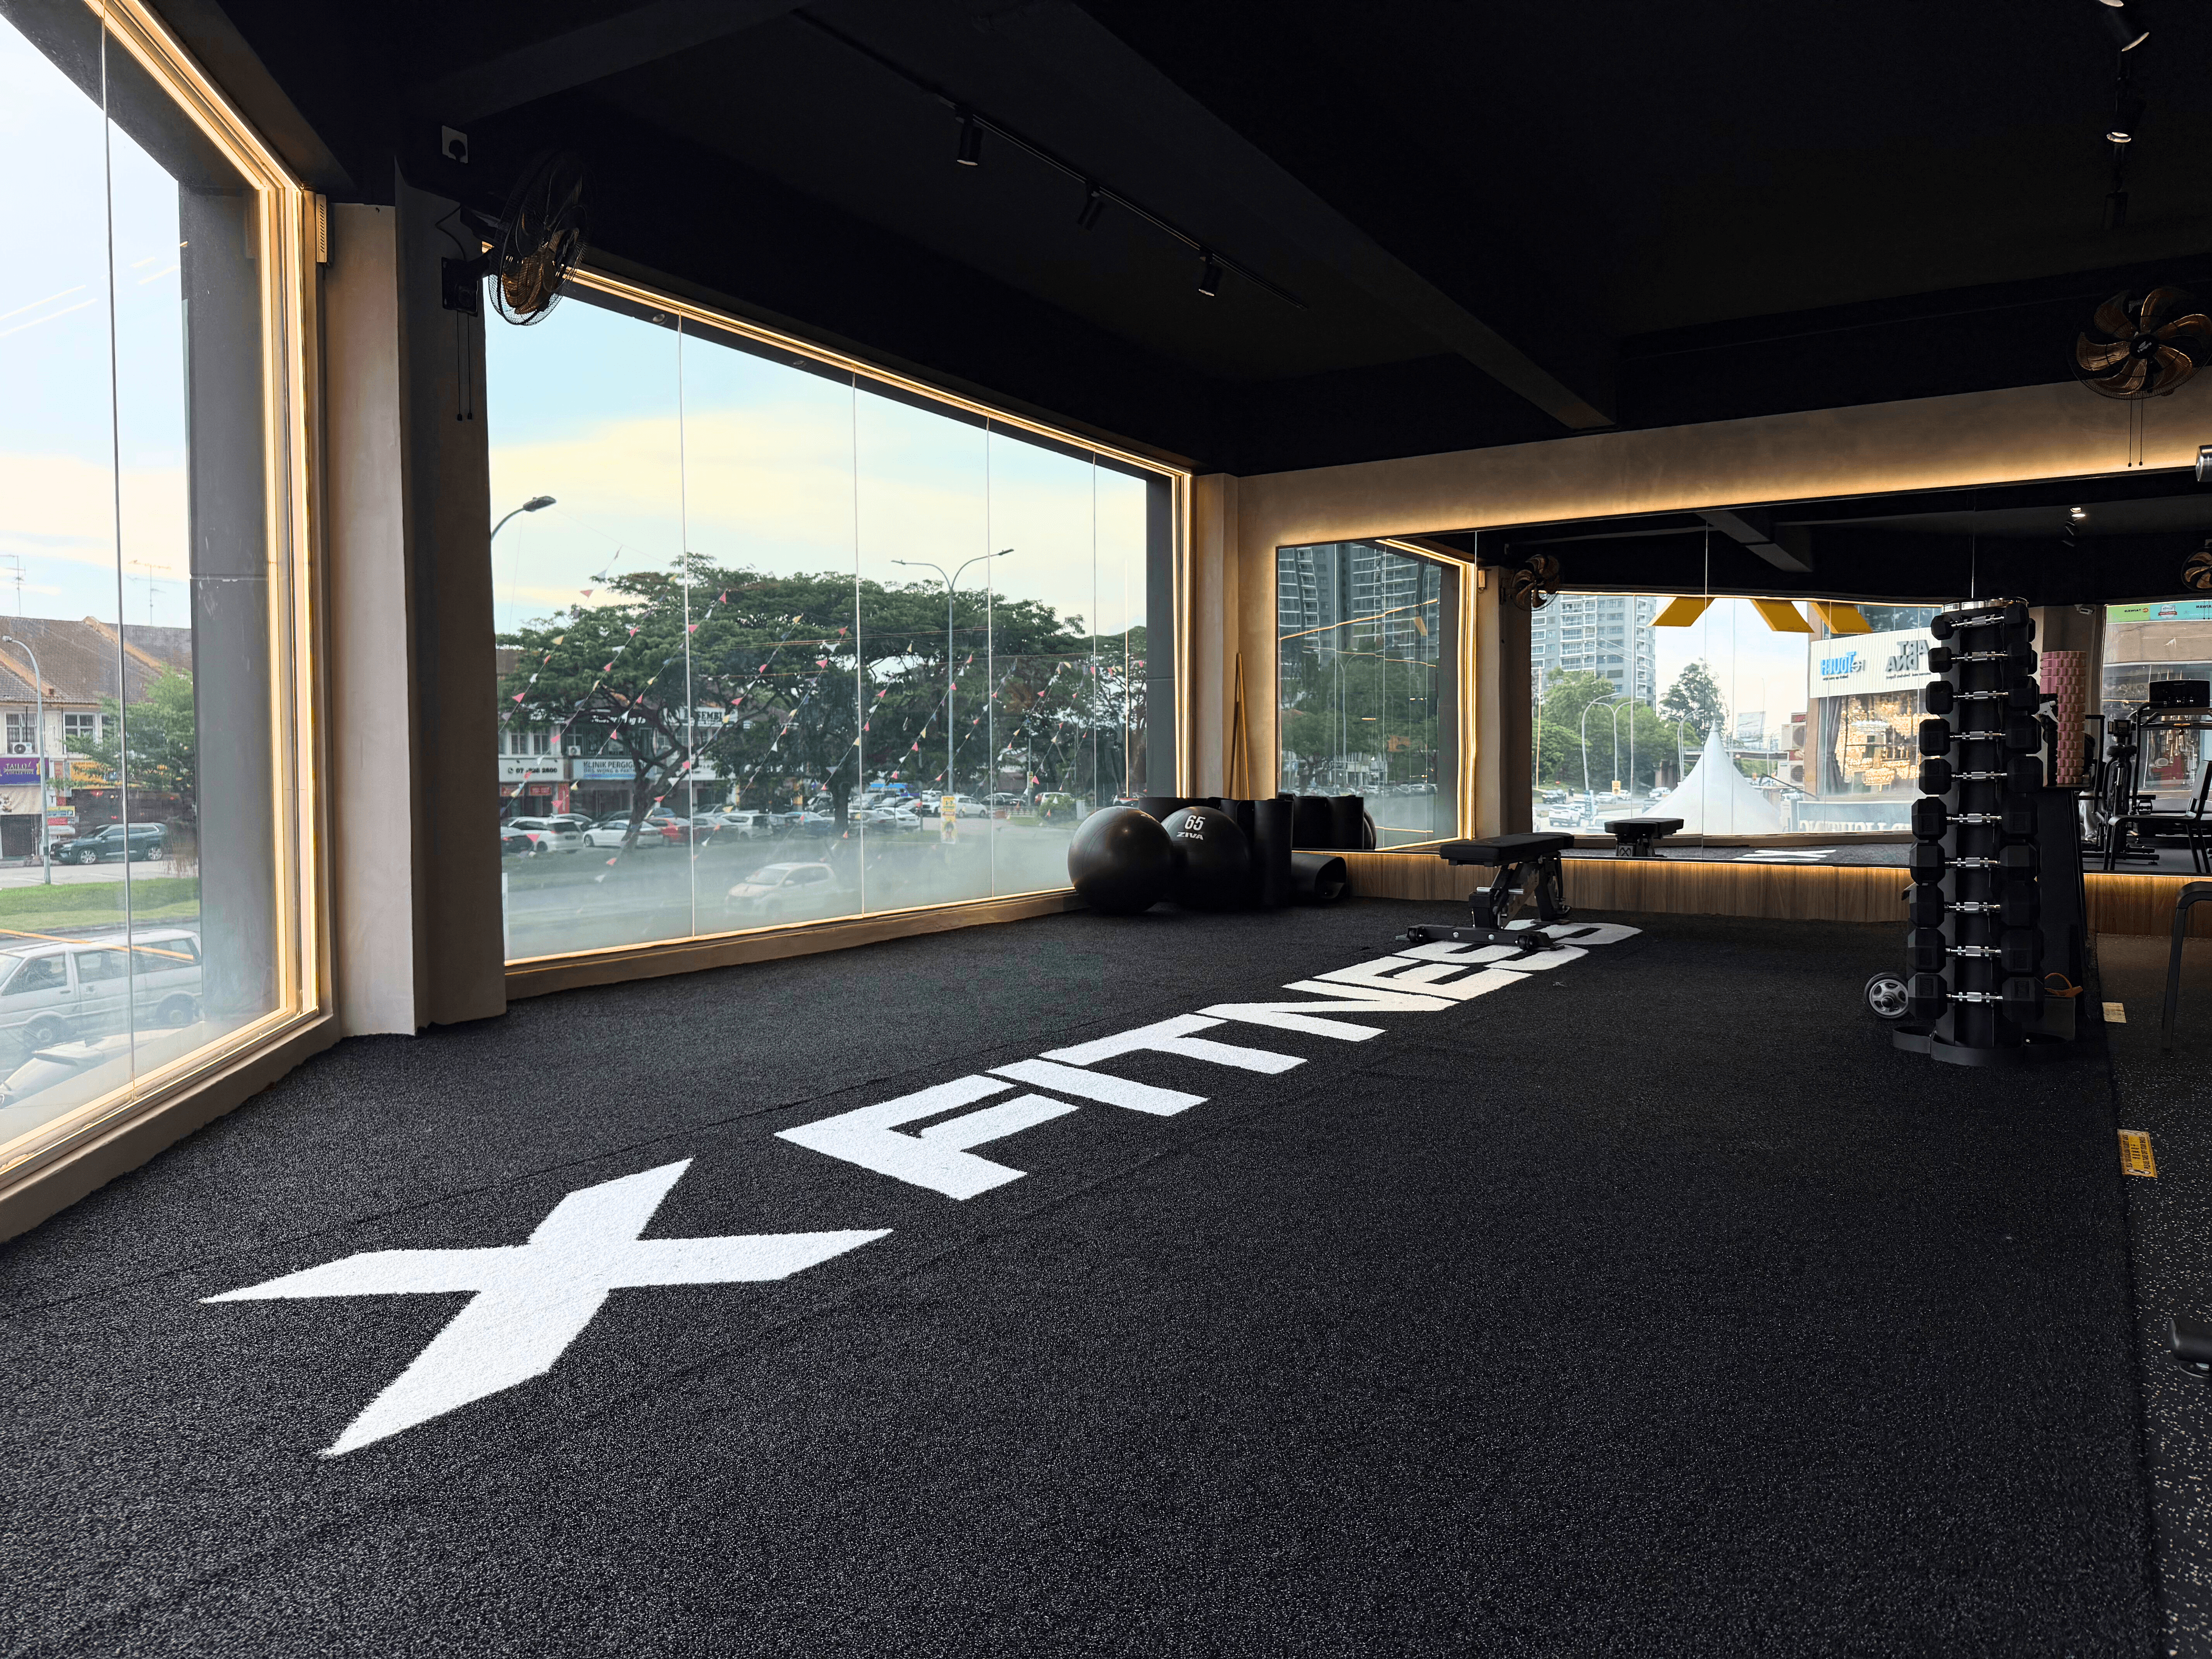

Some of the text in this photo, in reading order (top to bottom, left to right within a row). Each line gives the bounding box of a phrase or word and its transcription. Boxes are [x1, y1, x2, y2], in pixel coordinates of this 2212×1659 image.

[608, 761, 645, 770] PERGIGIN
[1184, 815, 1206, 831] 65
[1176, 831, 1204, 840] ZIVA
[200, 919, 1642, 1459] X FITNESS
